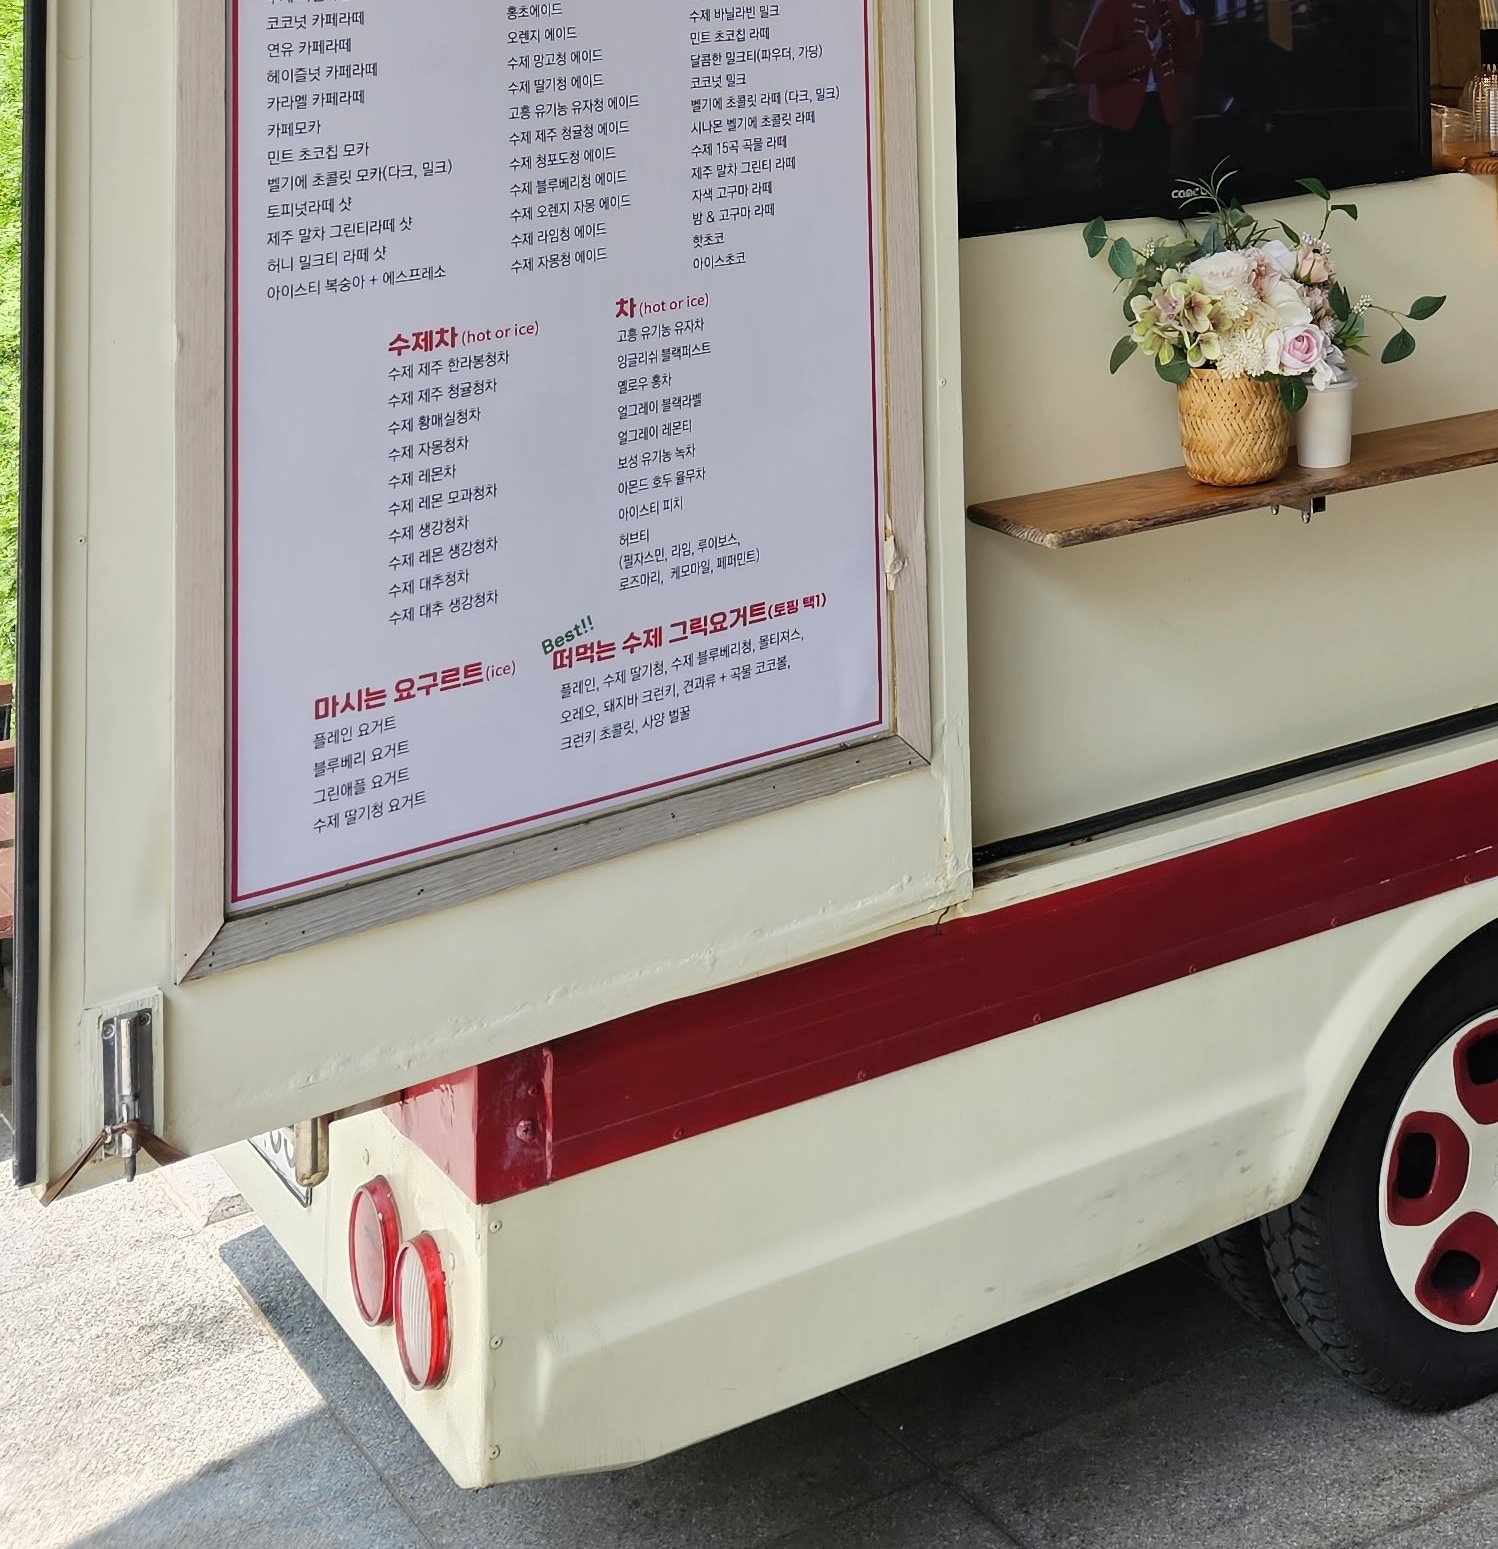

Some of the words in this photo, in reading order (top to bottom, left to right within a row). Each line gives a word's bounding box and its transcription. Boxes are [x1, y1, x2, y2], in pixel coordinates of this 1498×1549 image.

[266, 14, 306, 30] 코코넛
[311, 10, 364, 28] 카페라떼
[506, 2, 563, 21] 홍초에이드
[506, 28, 540, 44] 오렌지
[544, 26, 577, 41] 에이드
[267, 42, 294, 58] 연유
[298, 37, 351, 55] 카페라떼
[266, 65, 320, 85] 헤이즐넛
[325, 61, 378, 80] 카페라떼
[267, 93, 307, 112] 카라멜
[312, 89, 365, 108] 카페라떼
[267, 119, 322, 138] 카페모카
[267, 148, 294, 166] 민트
[297, 144, 338, 162] 초코칩
[342, 141, 370, 157] 모카
[690, 165, 713, 180] 제주
[716, 162, 737, 178] 말차
[775, 155, 796, 171] 라떼
[267, 173, 307, 193] 벨기에
[311, 169, 352, 187] 초콜릿
[715, 183, 749, 199] 고구마
[751, 180, 772, 195] 라떼
[266, 197, 335, 219] 토피넛라떼
[338, 196, 352, 212] 샷
[510, 231, 534, 248] 수제
[537, 226, 571, 244] 라임청
[573, 222, 607, 239] 에이드
[692, 232, 725, 249] 핫초코
[510, 257, 534, 274] 수제
[537, 251, 571, 270] 자몽청
[574, 247, 608, 264] 에이드
[692, 251, 746, 271] 아이스초코
[615, 296, 637, 319] 차
[638, 300, 666, 318] (hot
[669, 299, 684, 310] or
[686, 292, 709, 308] ice)
[387, 326, 459, 357] 수제차
[461, 328, 491, 347] (hot
[494, 327, 511, 339] or
[514, 320, 539, 336] ice)
[650, 372, 672, 389] 홍차
[387, 416, 413, 435] 수제
[417, 406, 481, 431] 황매실청차
[661, 418, 692, 436] 레몬티
[387, 444, 414, 462] 수제
[417, 434, 469, 457] 자몽청차
[387, 470, 414, 489] 수제
[418, 463, 456, 483] 레몬차
[618, 500, 659, 521] 아이스티
[662, 495, 683, 512] 피치
[388, 524, 414, 544] 수제
[418, 514, 469, 538] 생강청차
[618, 527, 650, 547] 허브티
[388, 578, 415, 598] 수제
[419, 568, 469, 591] 대추청차
[541, 614, 595, 656] Best!!
[552, 639, 617, 671] 떠먹는
[621, 625, 663, 655] 수제
[802, 591, 827, 609] 택1)
[314, 686, 387, 720] 마시는
[393, 661, 484, 703] 요구르트
[485, 659, 516, 682] (ice)
[357, 715, 397, 738] 요거트
[559, 729, 596, 750] 크런키
[641, 711, 665, 730] 사양
[370, 739, 409, 762] 요거트
[370, 767, 410, 790] 요거트
[313, 812, 340, 833] 수제
[344, 800, 383, 826] 딸기청
[387, 790, 427, 813] 요거트
